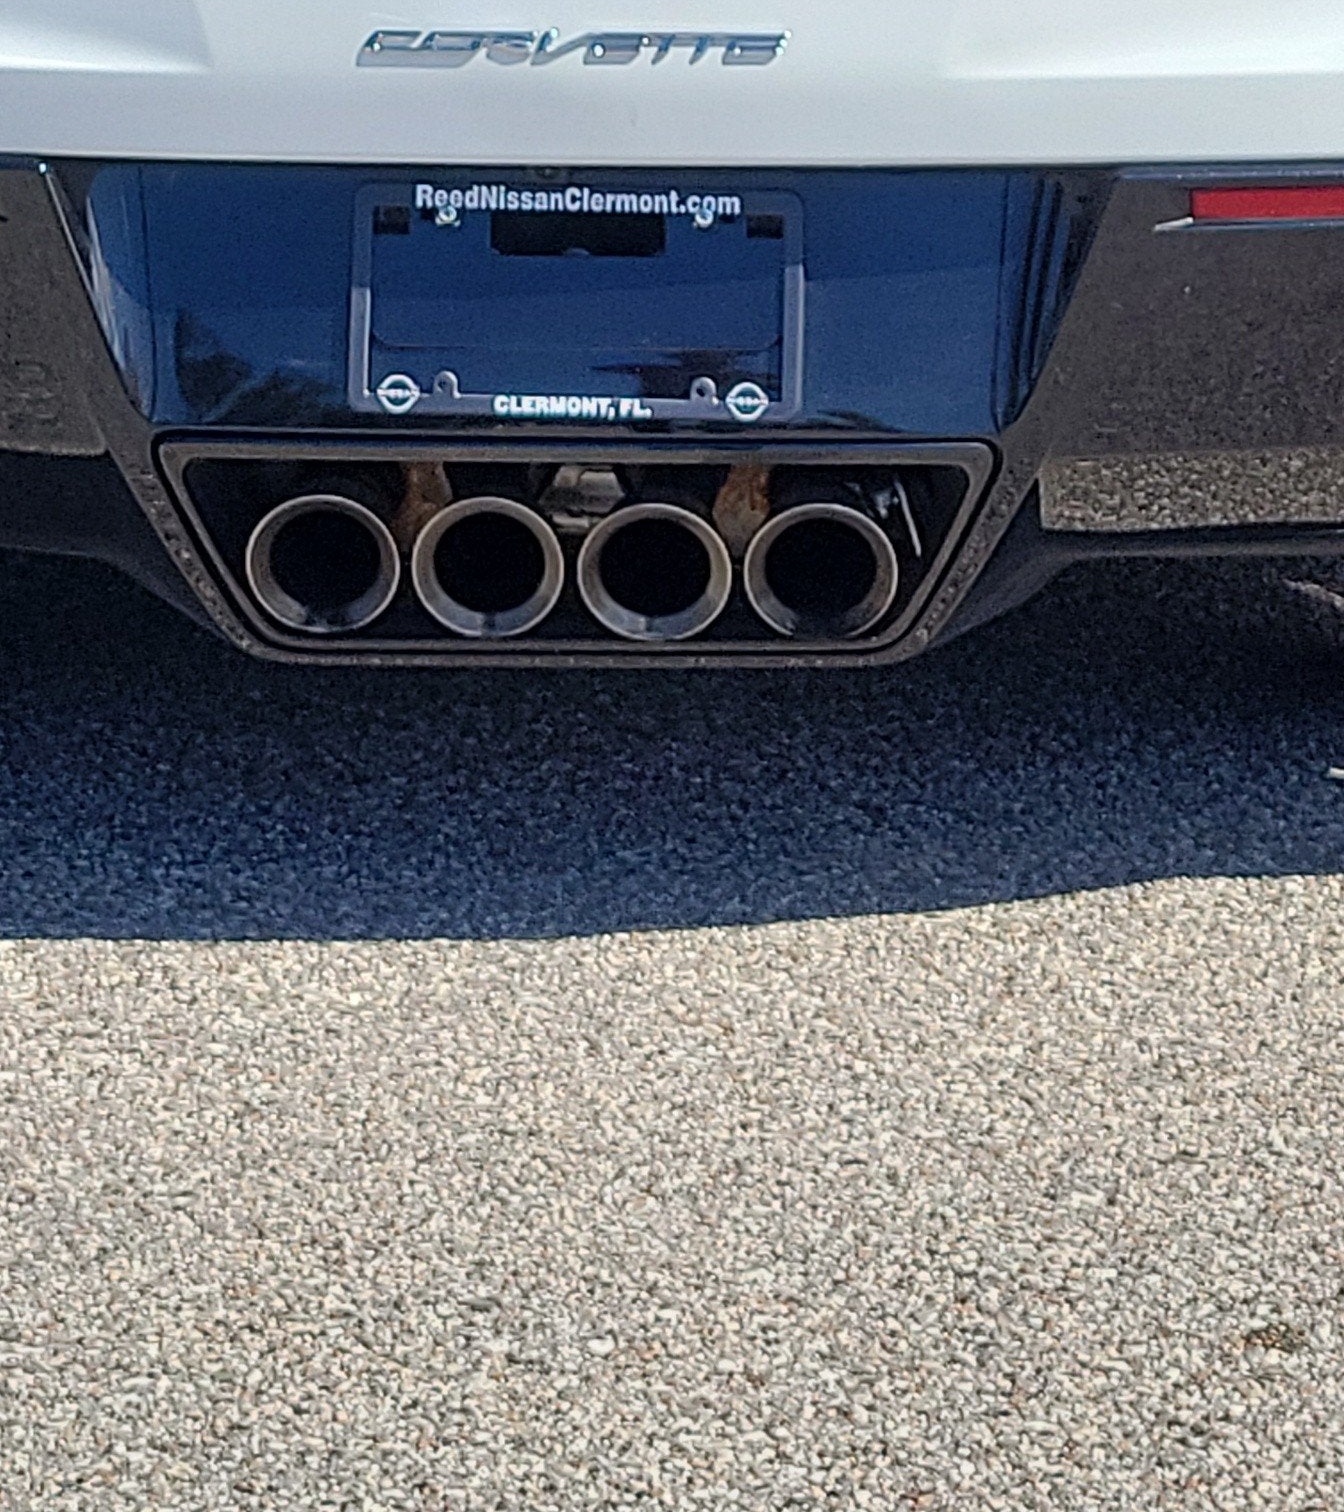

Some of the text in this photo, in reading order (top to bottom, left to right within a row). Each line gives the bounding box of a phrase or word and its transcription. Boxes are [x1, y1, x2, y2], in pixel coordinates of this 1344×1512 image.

[415, 184, 741, 215] ReedNissanClermont.com
[493, 394, 653, 421] CLERMONT, FL.
